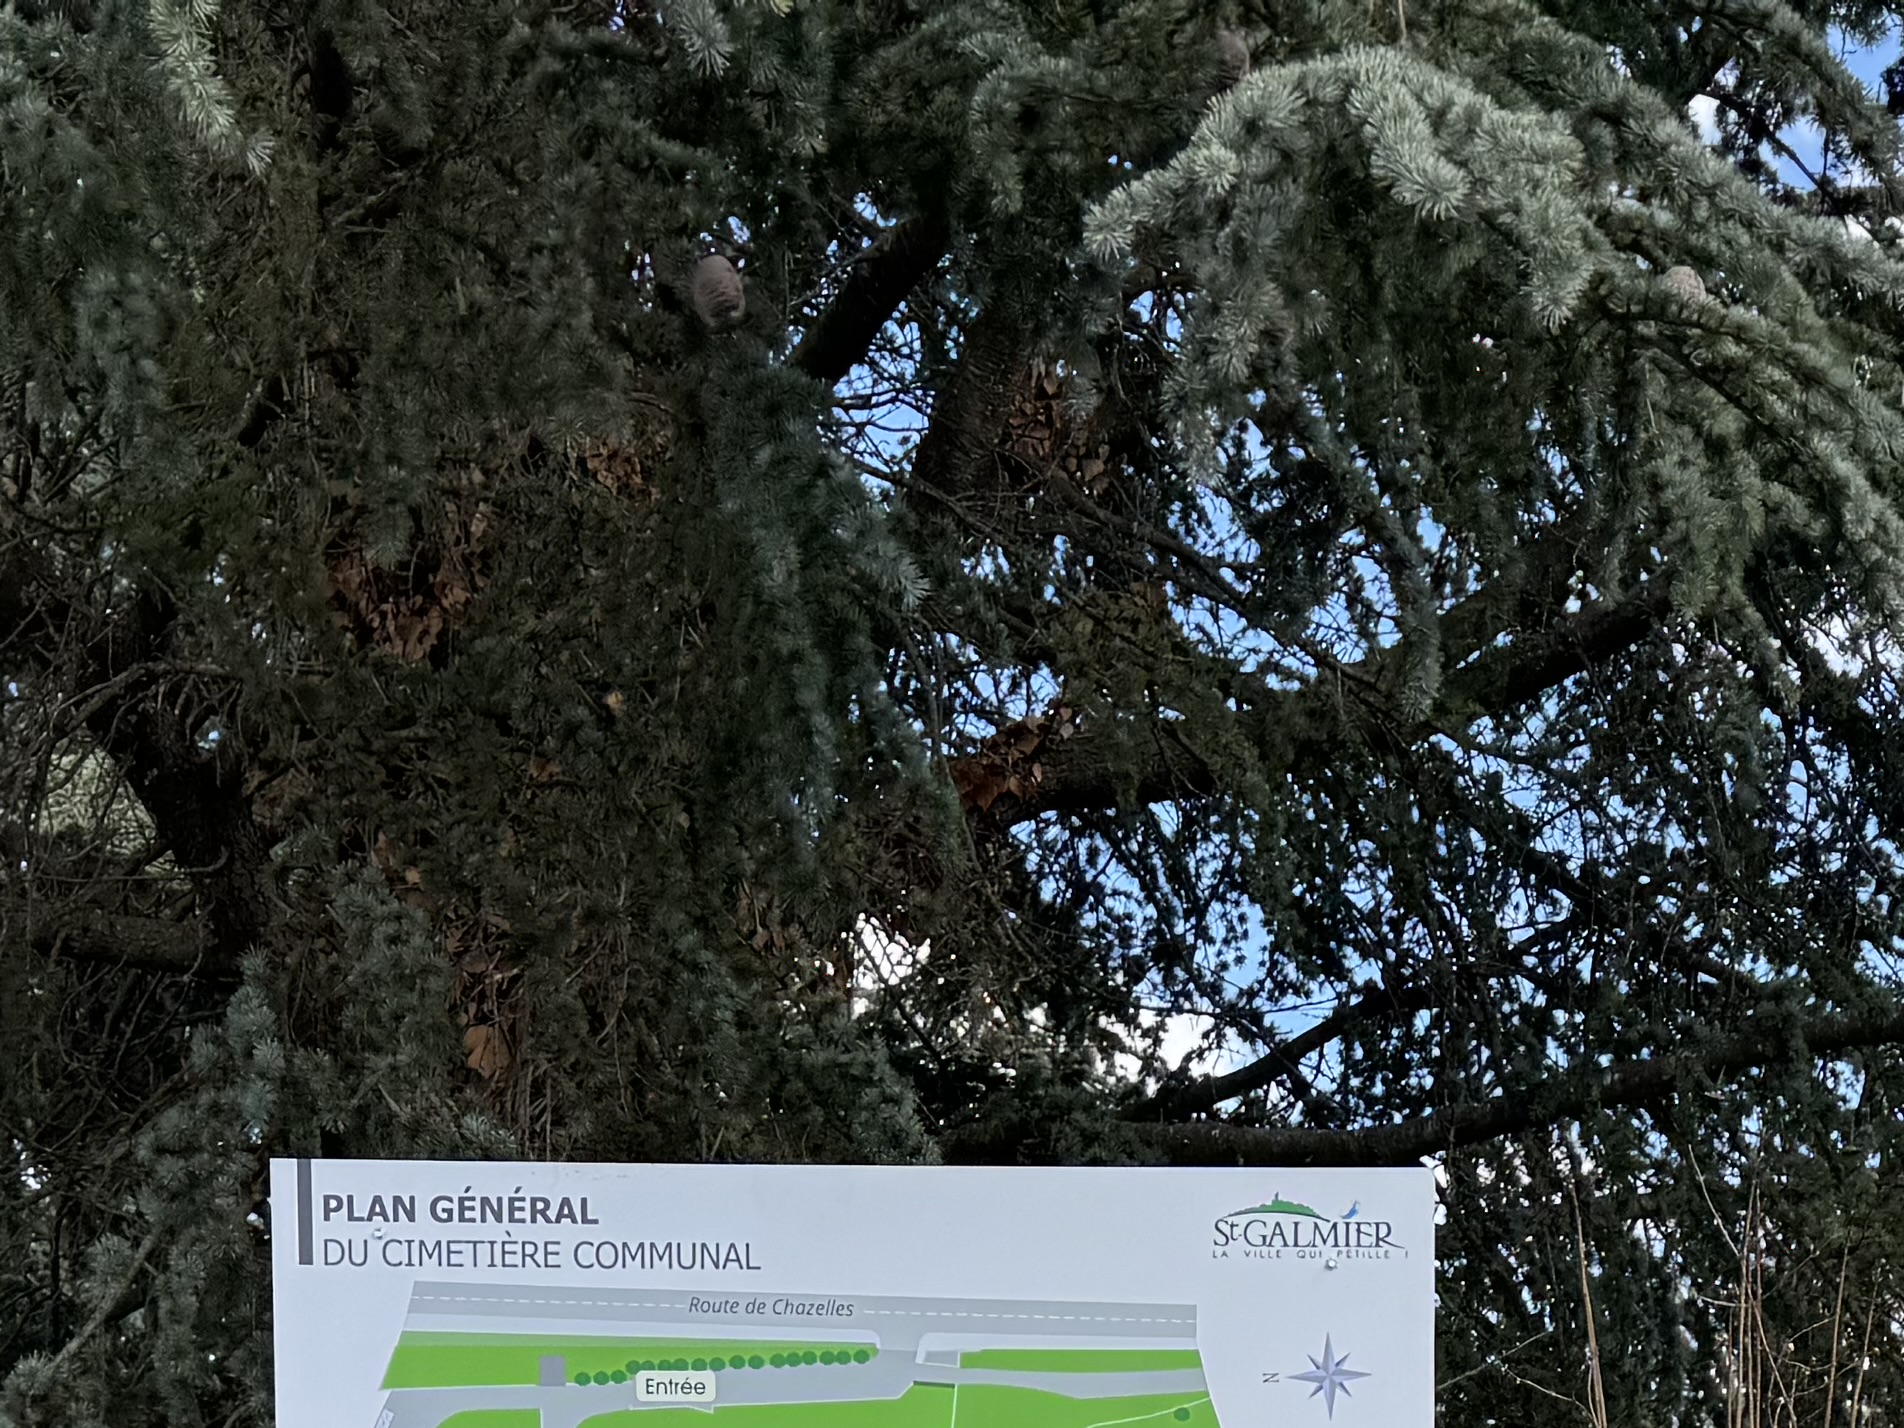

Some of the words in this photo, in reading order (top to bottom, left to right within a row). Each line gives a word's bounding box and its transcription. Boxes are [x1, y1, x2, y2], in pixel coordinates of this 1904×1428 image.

[322, 1194, 416, 1223] PLAN
[429, 1185, 600, 1225] GÉNÉRAL
[323, 1238, 368, 1267] DU
[382, 1230, 562, 1269] CIMETIÈRE
[573, 1240, 762, 1270] COMMUNAL
[1212, 1250, 1229, 1259] LA
[1243, 1249, 1281, 1259] VILLE
[1296, 1249, 1322, 1259] QUI
[688, 1296, 740, 1314] Route
[745, 1297, 767, 1315] de
[772, 1298, 854, 1317] Chazelles
[645, 1377, 706, 1395] Entrée
